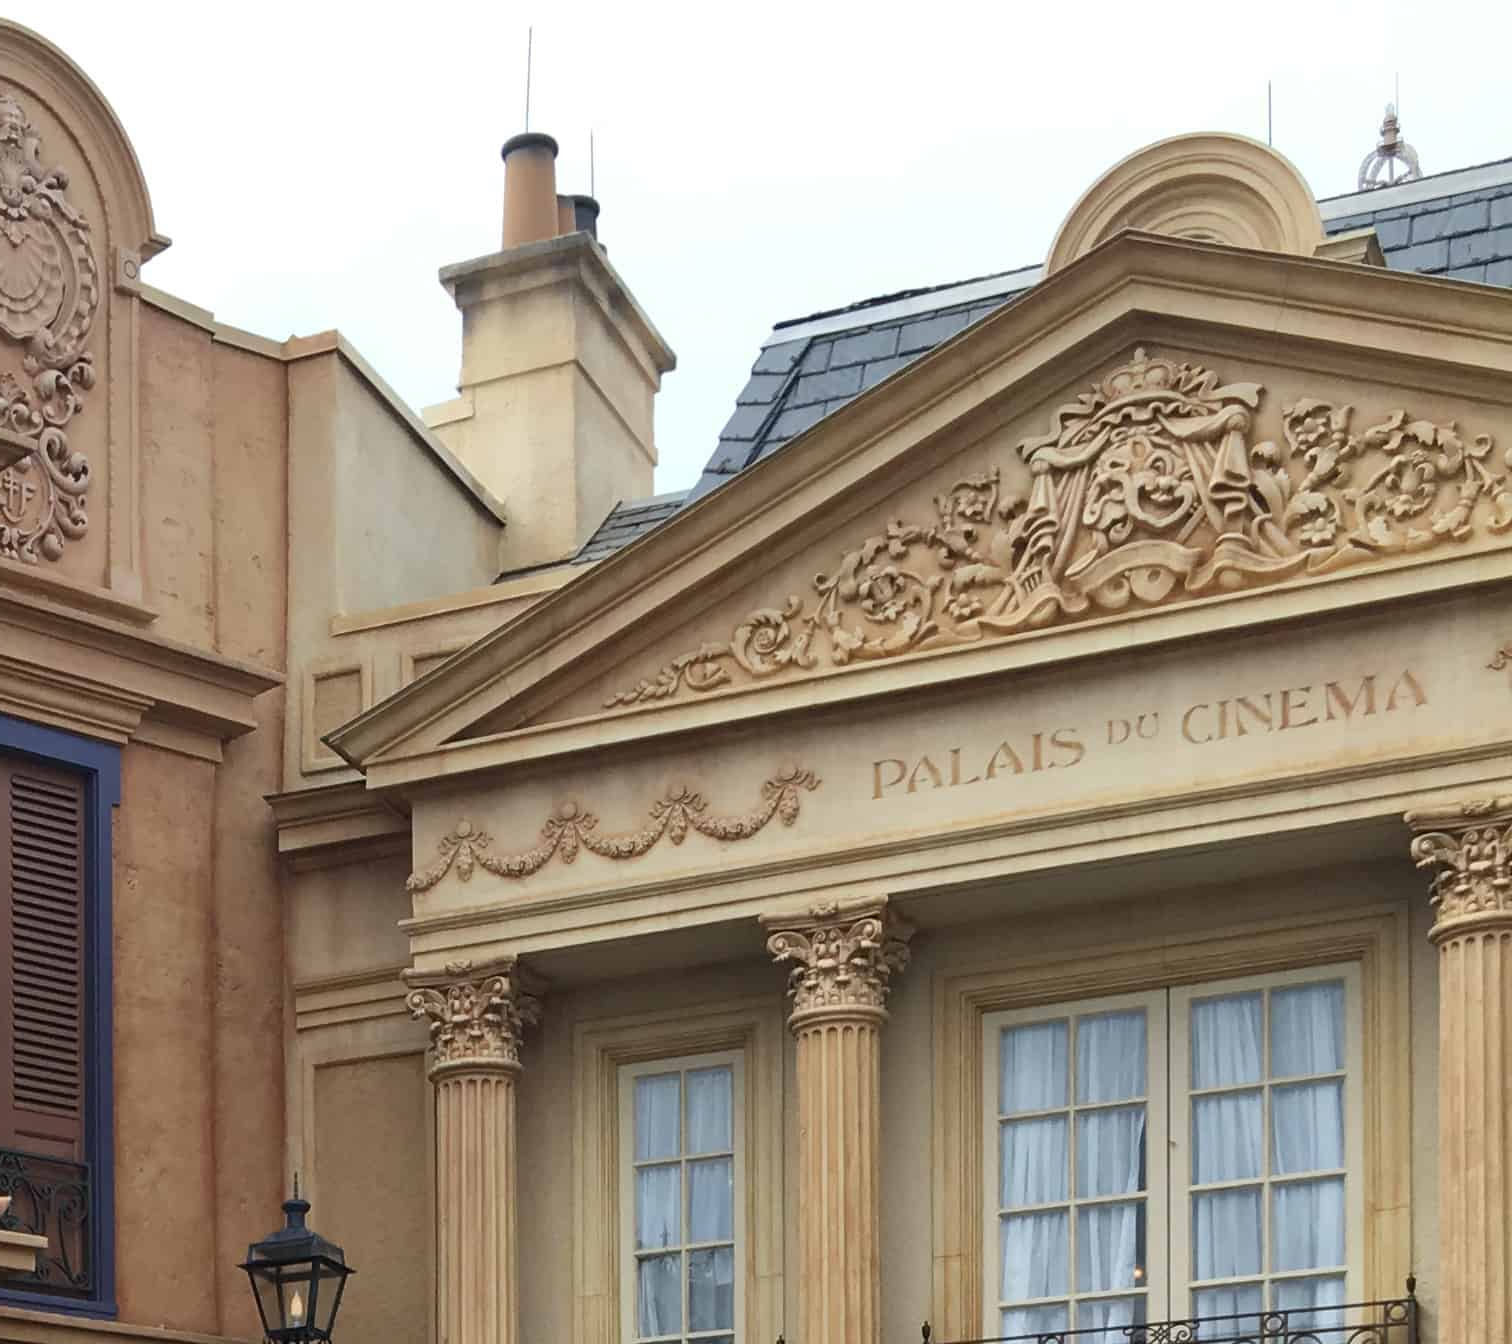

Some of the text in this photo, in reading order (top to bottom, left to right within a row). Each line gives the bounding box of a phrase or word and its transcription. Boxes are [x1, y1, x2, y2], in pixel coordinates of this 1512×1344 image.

[871, 669, 1429, 800] PALAIS DU CINEMA
